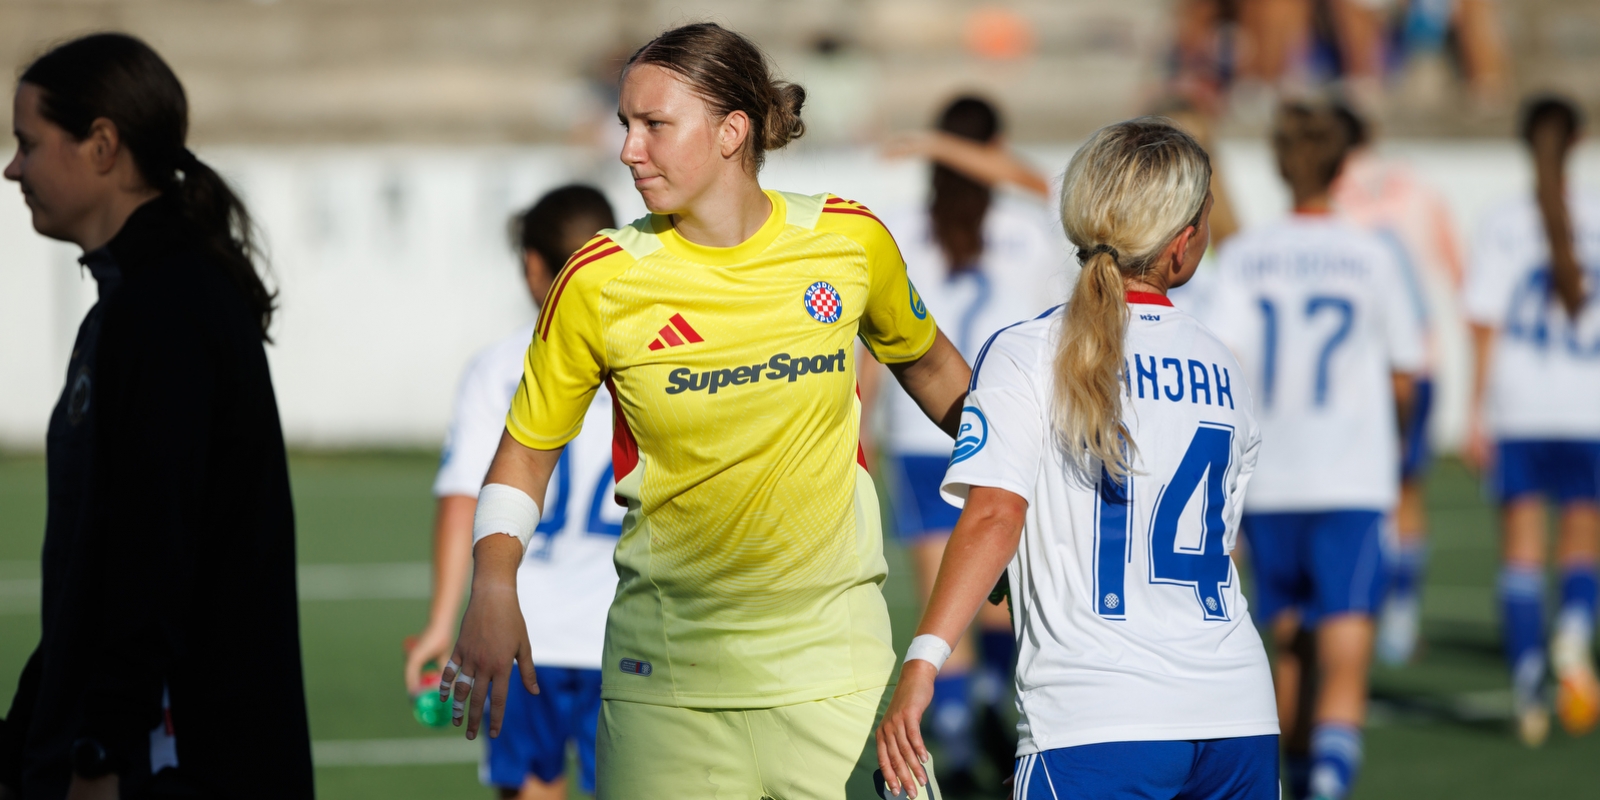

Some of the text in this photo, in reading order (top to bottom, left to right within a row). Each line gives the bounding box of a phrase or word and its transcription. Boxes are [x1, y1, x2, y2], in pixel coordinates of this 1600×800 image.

[806, 281, 838, 297] HAJDUK
[813, 311, 839, 324] SPLIT
[665, 348, 846, 396] SuperSport
[1256, 292, 1354, 411] 17
[1092, 420, 1235, 622] 14
